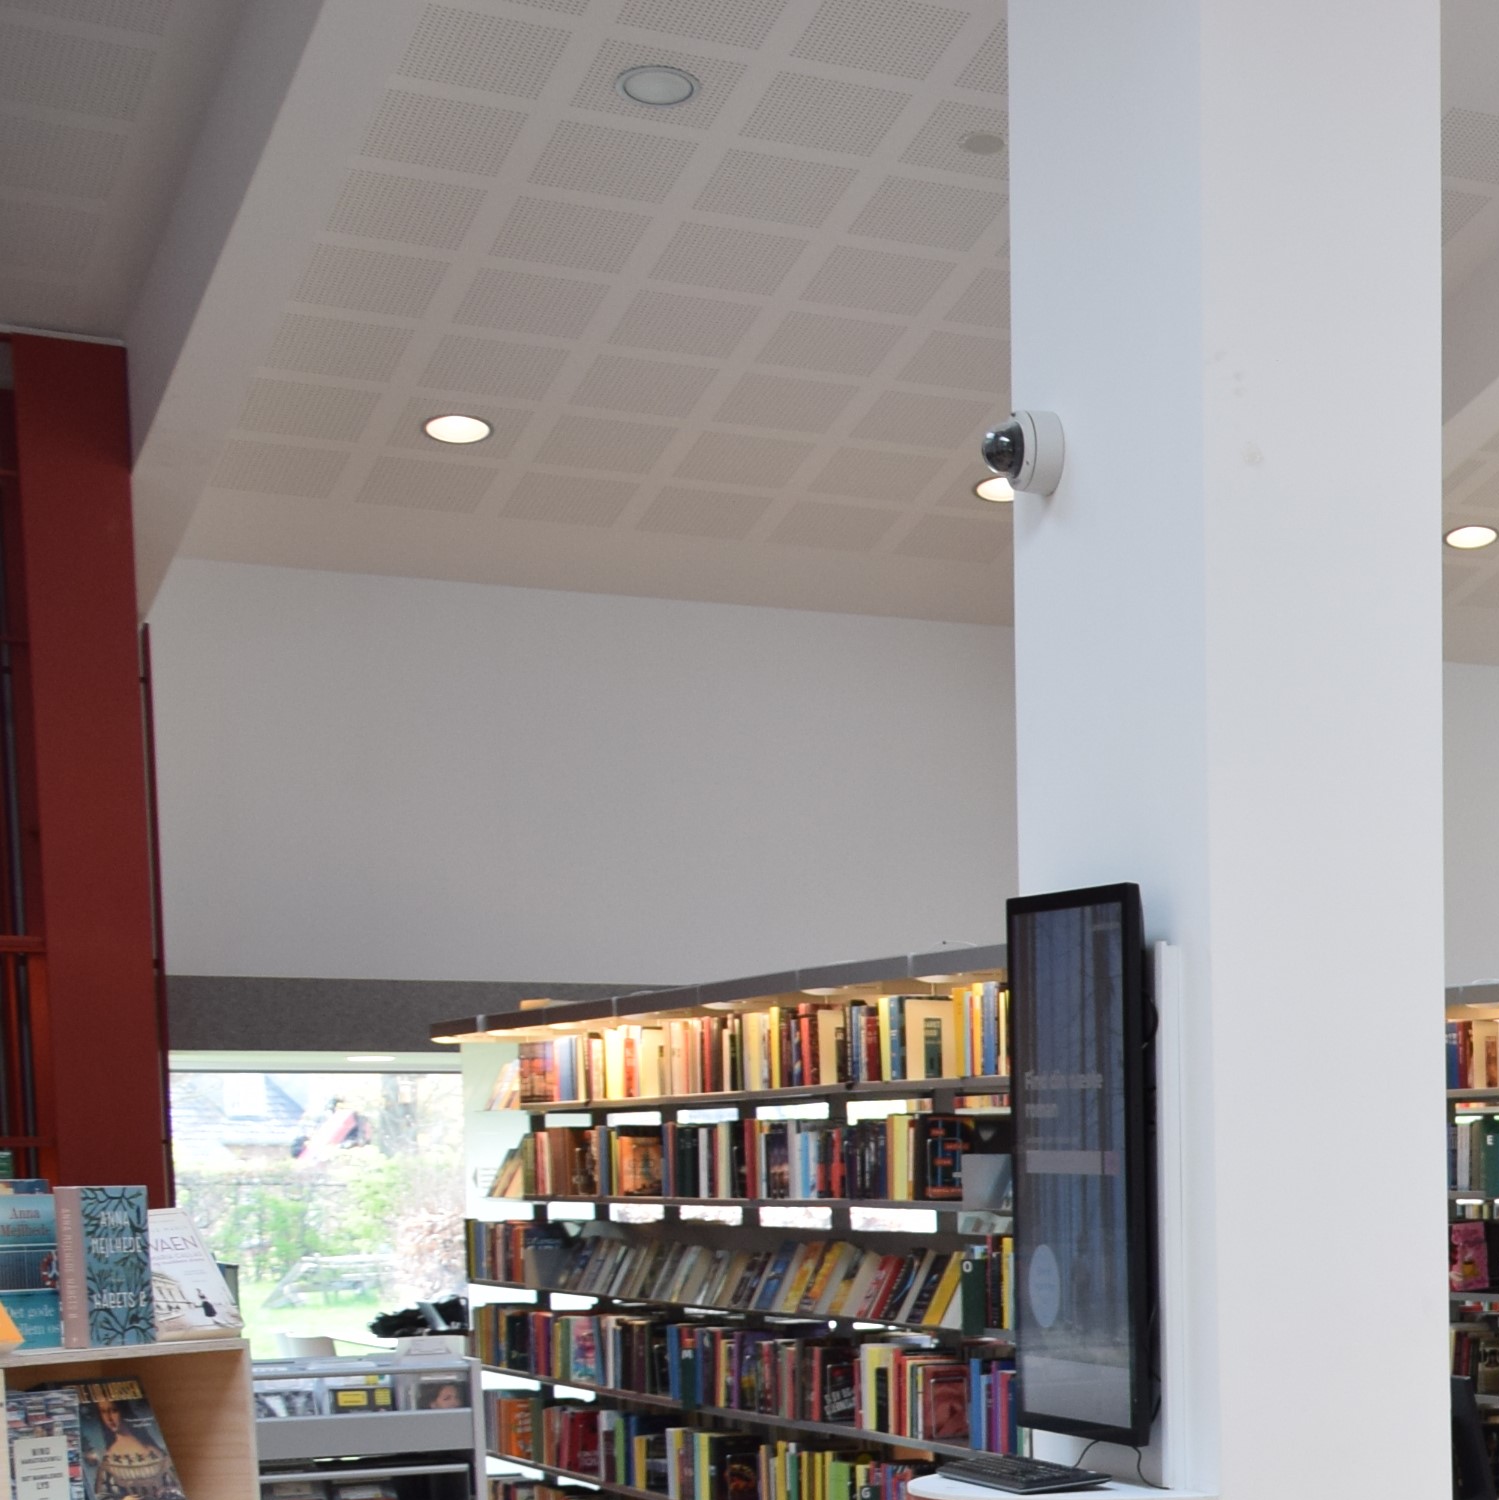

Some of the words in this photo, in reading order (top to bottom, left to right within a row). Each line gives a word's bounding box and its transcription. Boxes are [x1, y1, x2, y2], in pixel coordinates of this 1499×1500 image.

[1486, 1135, 1494, 1146] E
[9, 1207, 41, 1219] Anna
[100, 1211, 130, 1228] ANNA
[91, 1235, 142, 1257] MEJLHEDE
[861, 1486, 872, 1499] G
